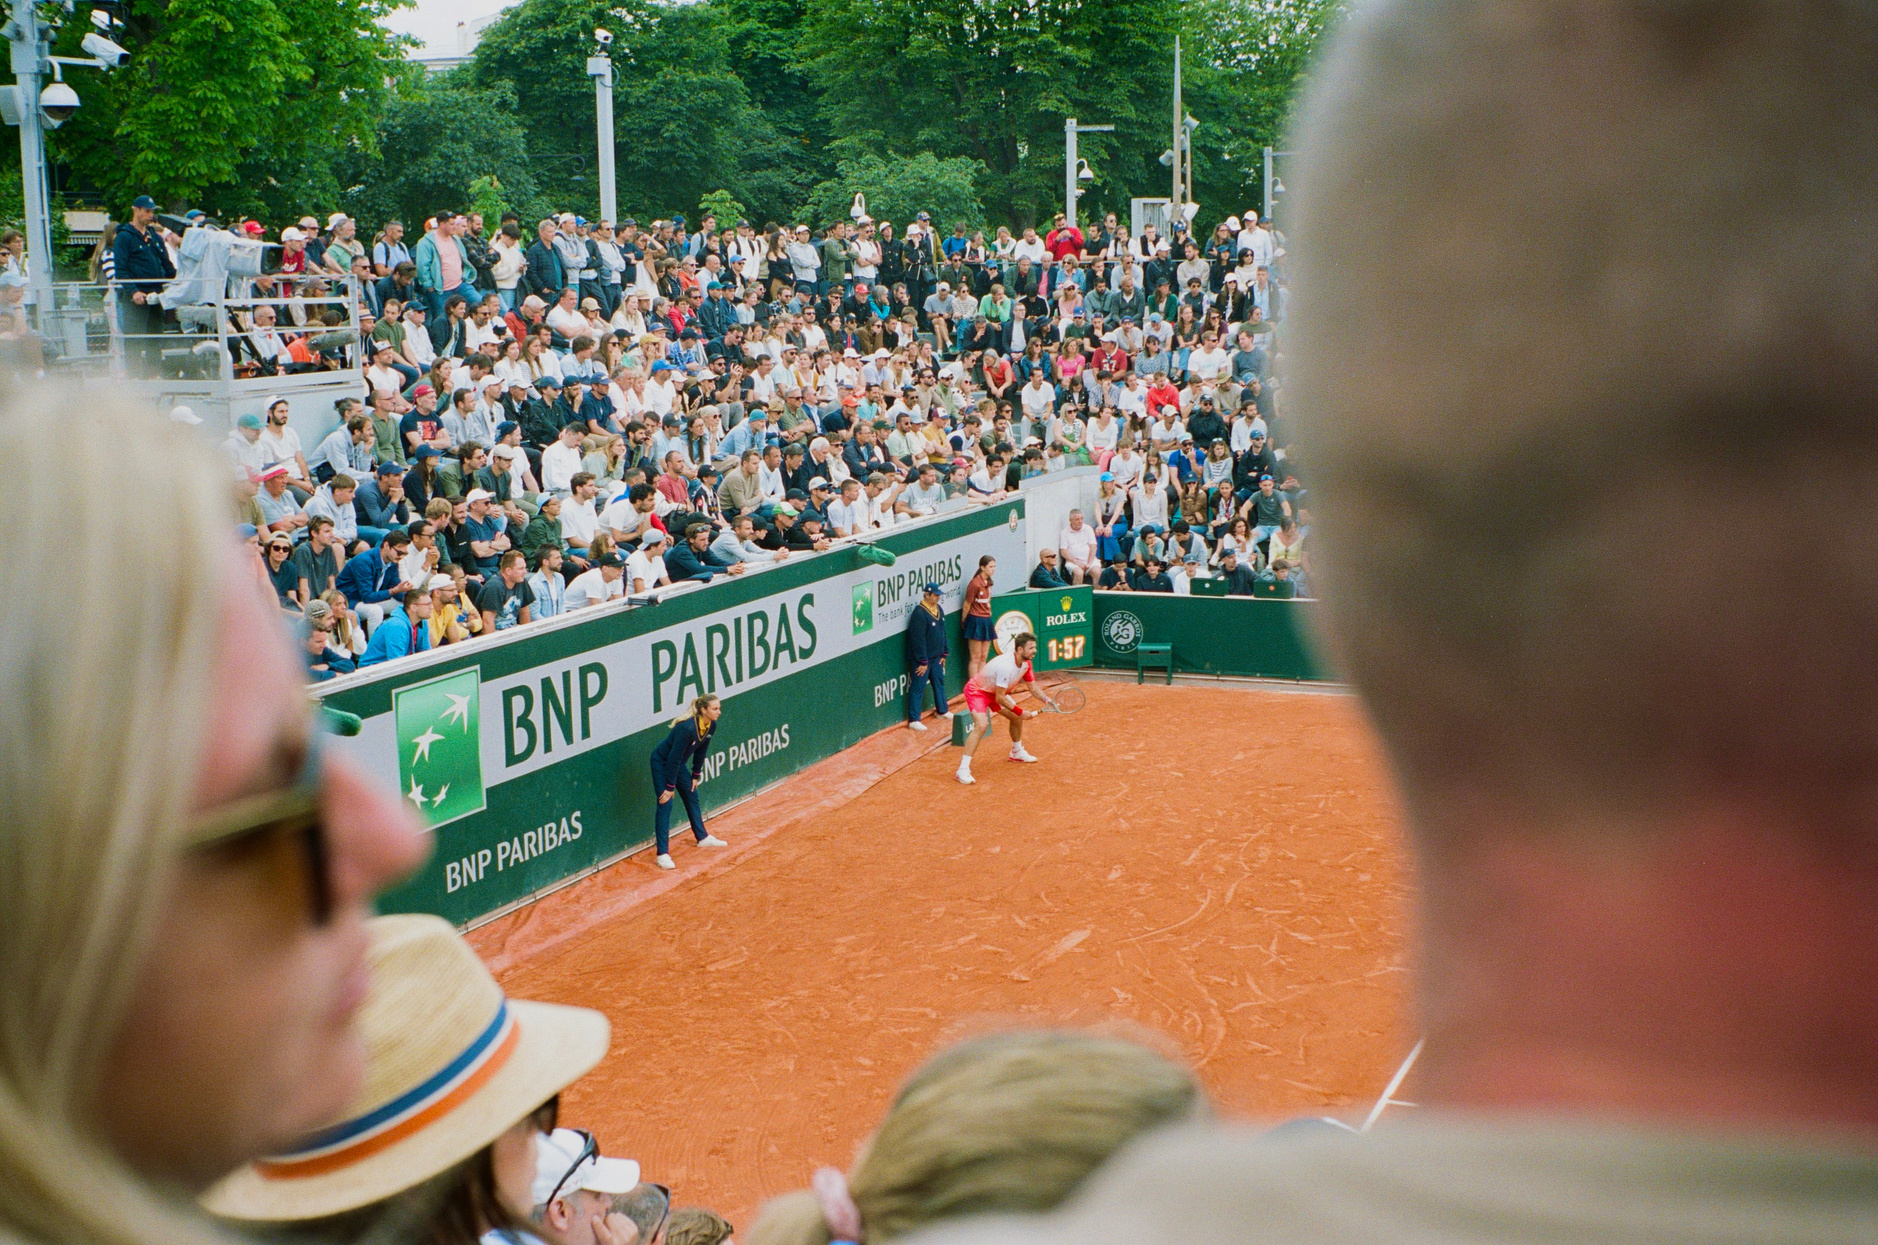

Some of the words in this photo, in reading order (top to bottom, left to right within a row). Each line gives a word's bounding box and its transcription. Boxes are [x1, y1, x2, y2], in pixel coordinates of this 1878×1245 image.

[878, 573, 905, 608] BNP
[908, 554, 962, 597] PARIBAS
[878, 612, 889, 624] The
[890, 605, 903, 620] bank
[1046, 612, 1086, 627] ROLEX
[1047, 635, 1086, 662] 1:57
[502, 662, 608, 768] BNP
[651, 593, 817, 714] PARIBAS
[874, 678, 898, 708] BNP
[729, 723, 790, 771] PARIBAS
[446, 849, 492, 893] BNP
[497, 810, 583, 872] PARIBAS
